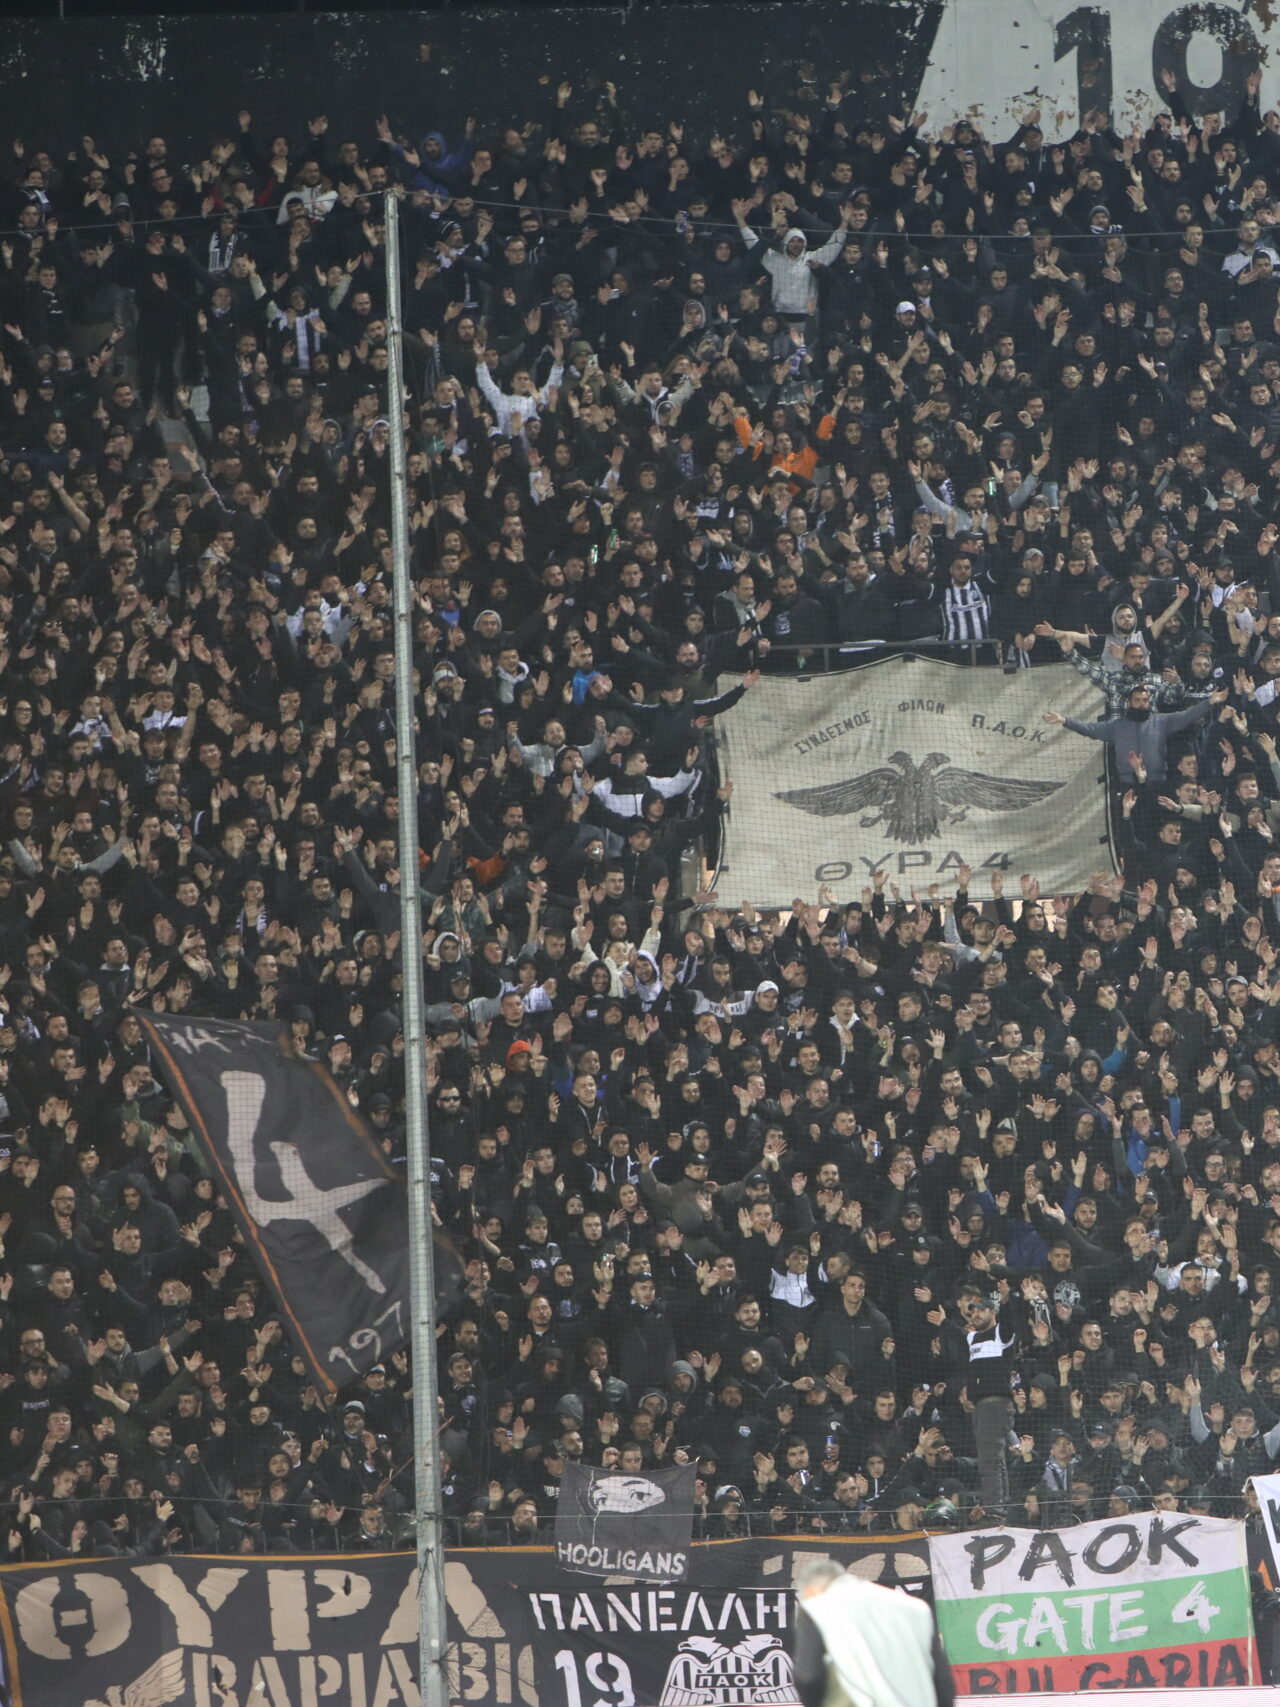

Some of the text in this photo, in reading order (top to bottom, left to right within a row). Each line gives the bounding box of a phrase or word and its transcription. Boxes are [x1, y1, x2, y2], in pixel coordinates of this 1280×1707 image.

[814, 850, 1014, 882] ΘΥΡΑ 4
[328, 1301, 405, 1374] 197
[558, 1541, 686, 1576] HOOLIGANS
[964, 1518, 1201, 1590] PAOK
[15, 1561, 506, 1660] ΘΥΡΑ
[529, 1590, 801, 1632] ΠΑΝΕΛΛΗ
[976, 1581, 1221, 1655] GATE 4
[698, 1674, 772, 1687] ΠΑΟΚ
